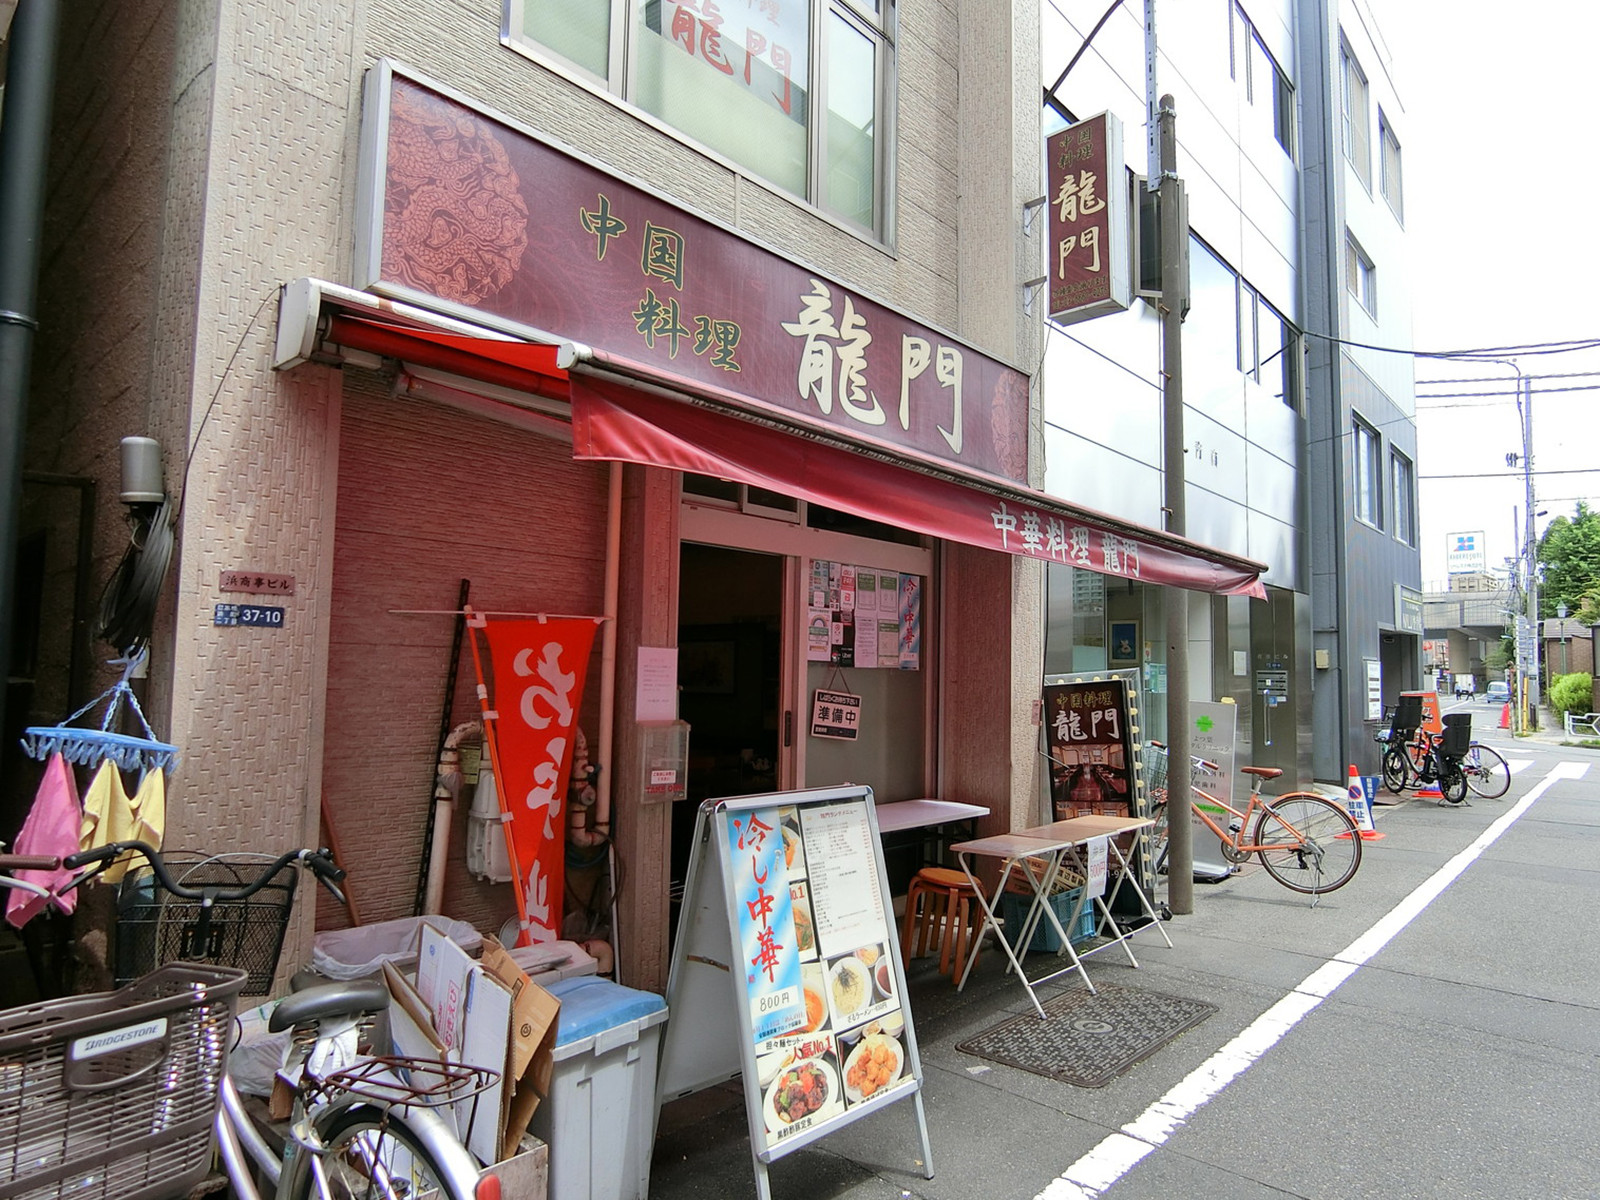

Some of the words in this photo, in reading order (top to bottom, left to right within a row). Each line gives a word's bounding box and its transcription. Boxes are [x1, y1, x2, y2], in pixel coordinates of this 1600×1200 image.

[1052, 169, 1106, 280] 龍門
[579, 192, 685, 292] 中国
[632, 289, 743, 373] 料理
[780, 278, 964, 455] 龍門
[991, 501, 1091, 566] 中華料理
[1101, 531, 1140, 578] 龍門
[226, 575, 290, 590] 浜商事ビル
[243, 609, 281, 623] 37-10
[818, 705, 856, 725] 準備中
[1051, 708, 1120, 742] 龍門
[734, 812, 784, 982] 冷し中華
[760, 991, 790, 1012] 800円
[85, 1025, 158, 1051] BRIDGESTONE
[791, 1036, 833, 1064] 人気No.1
